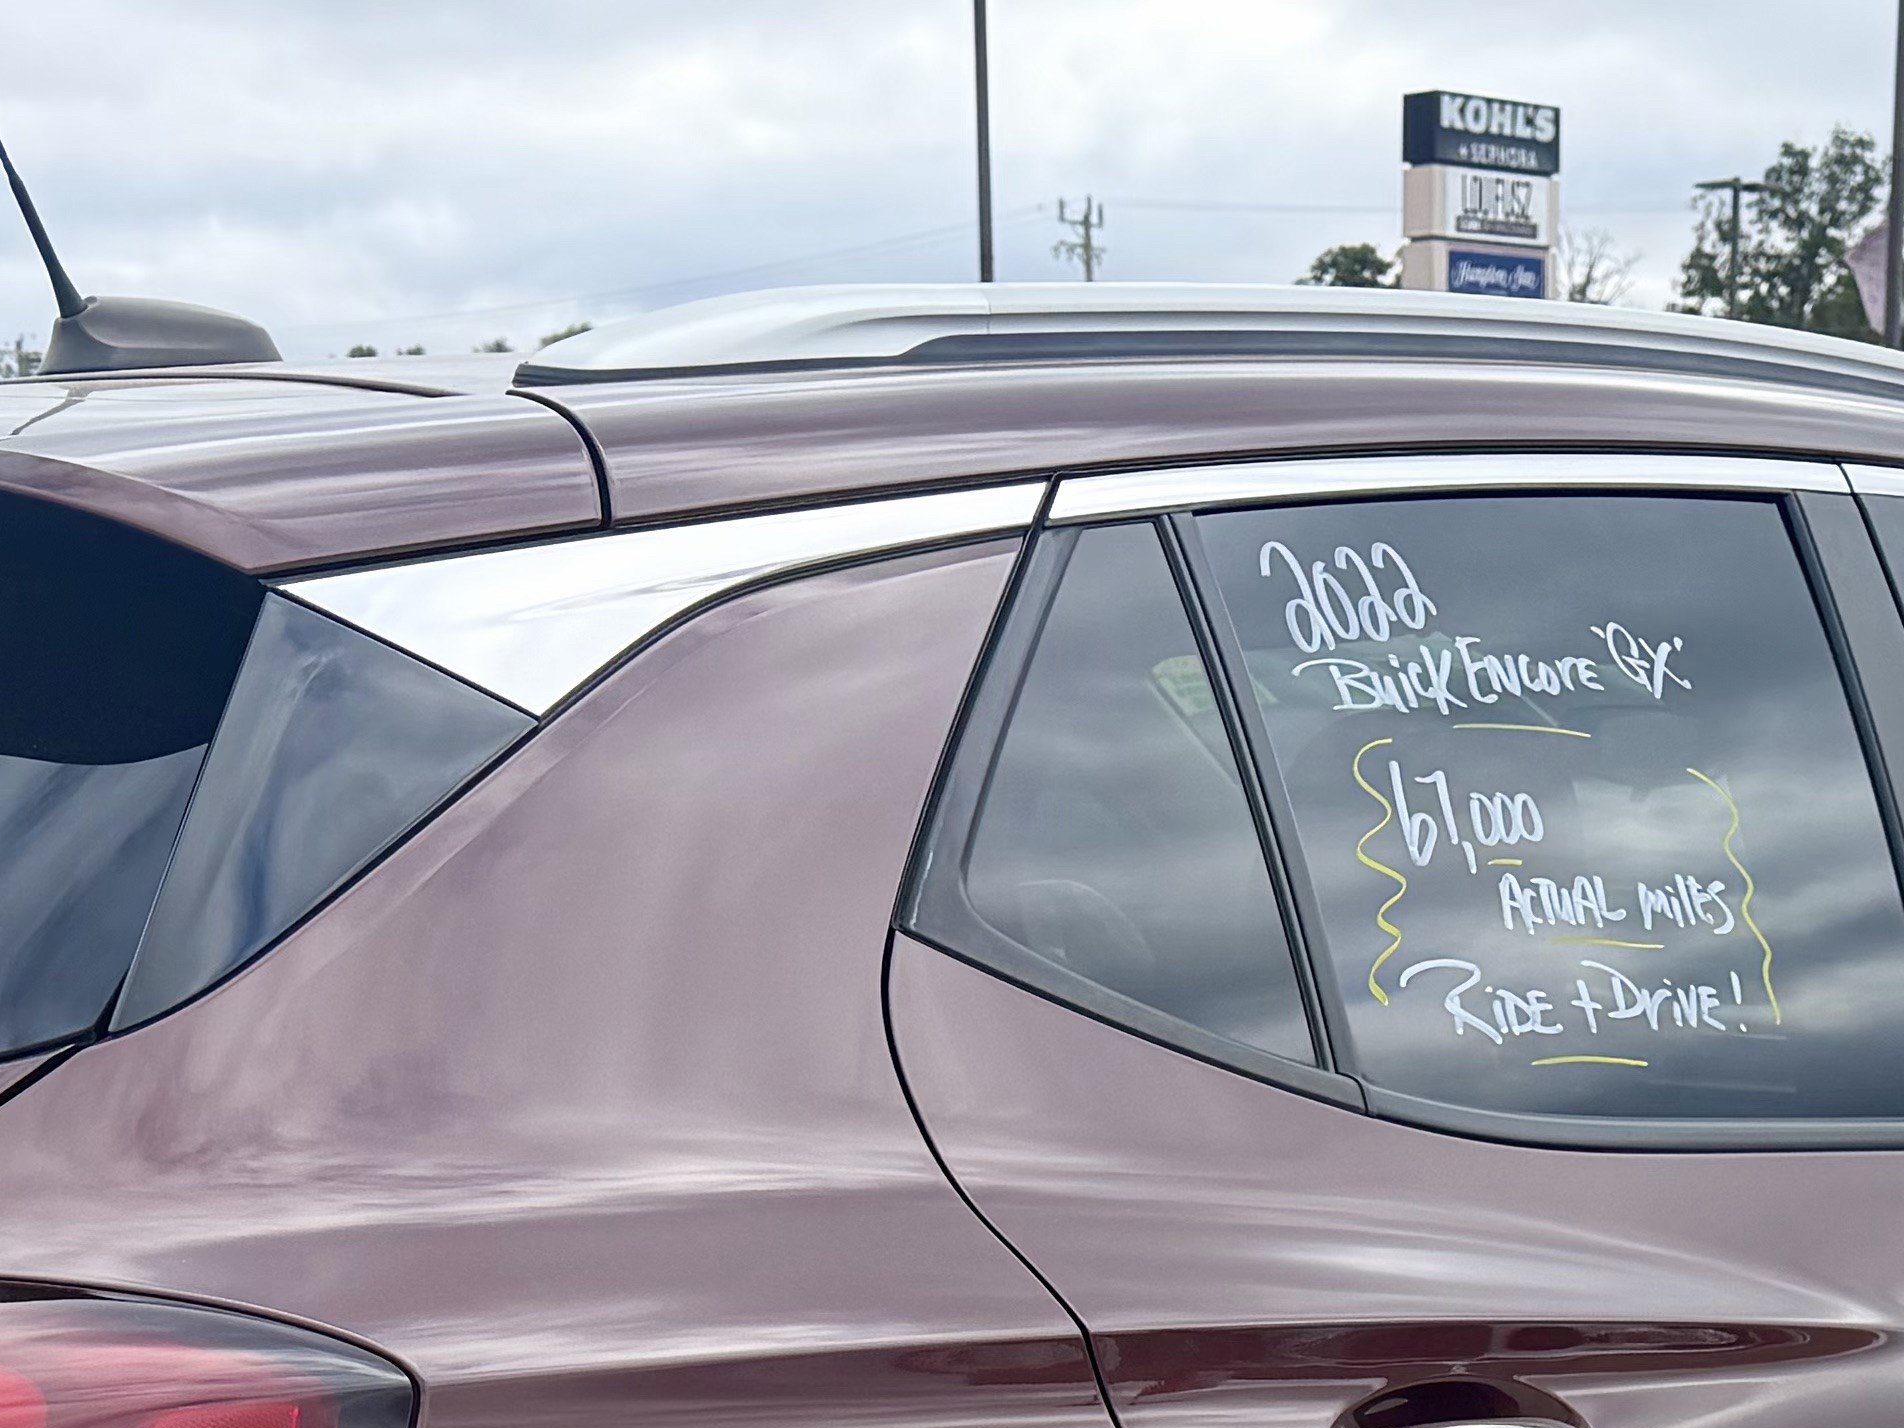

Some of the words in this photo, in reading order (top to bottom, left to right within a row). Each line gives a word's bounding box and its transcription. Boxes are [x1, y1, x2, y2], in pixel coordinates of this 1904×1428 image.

[1440, 93, 1556, 143] KOHL'S
[1259, 541, 1438, 654] 2022
[1388, 760, 1545, 875] 67,000
